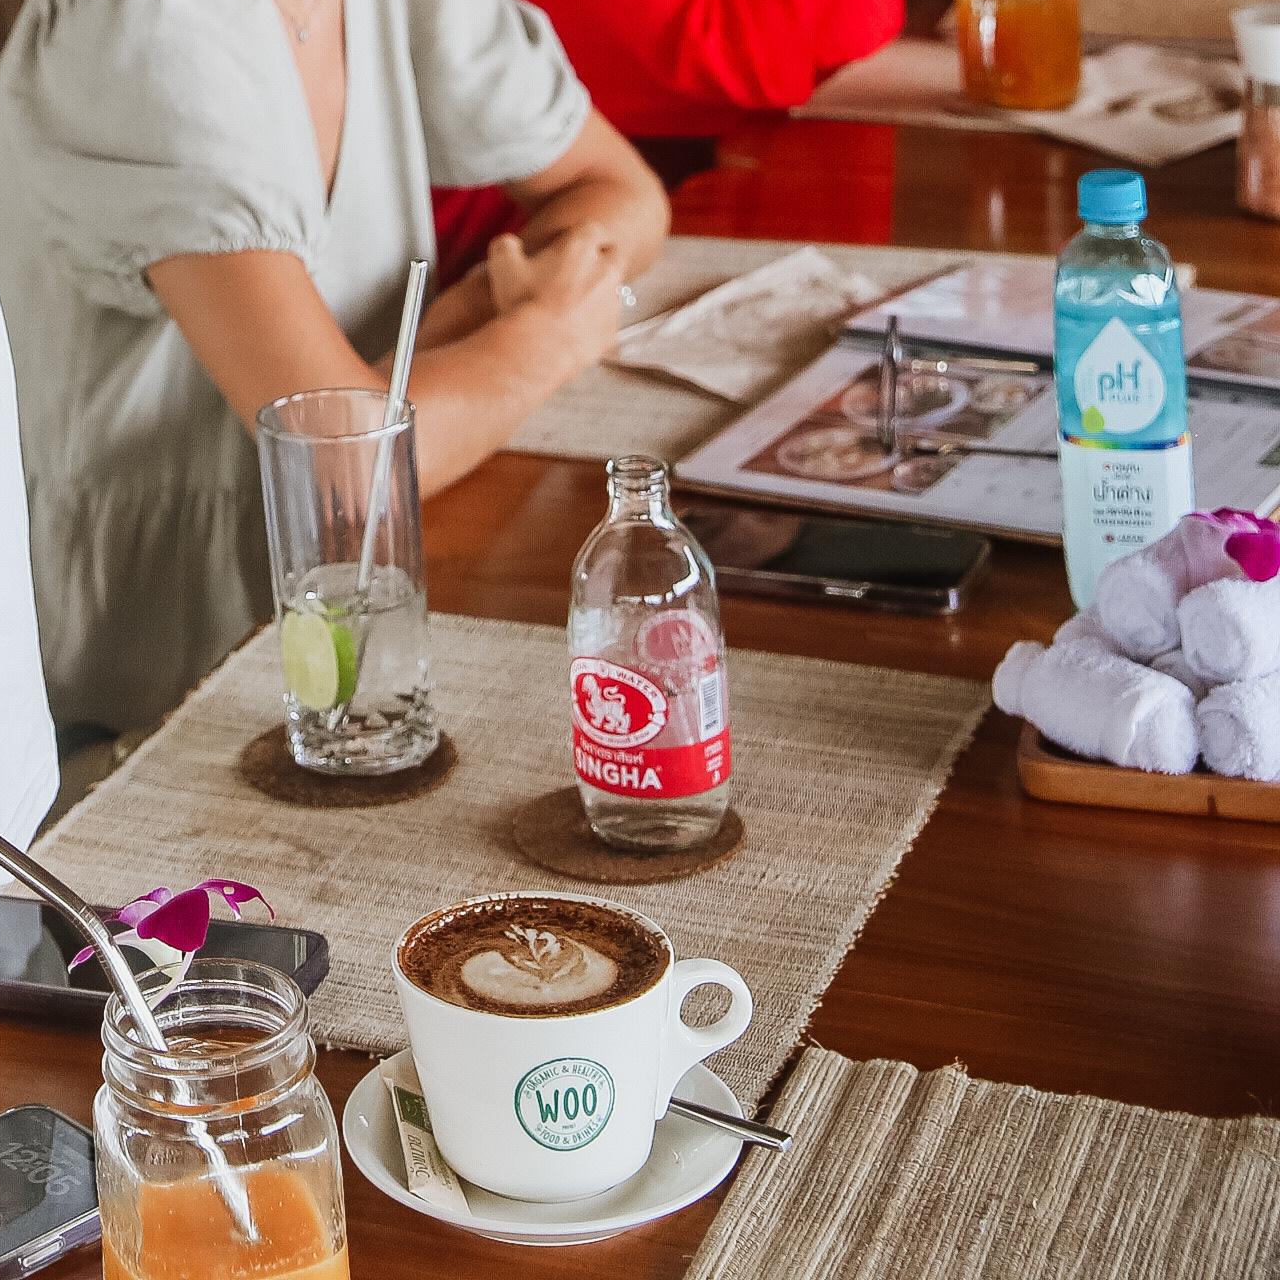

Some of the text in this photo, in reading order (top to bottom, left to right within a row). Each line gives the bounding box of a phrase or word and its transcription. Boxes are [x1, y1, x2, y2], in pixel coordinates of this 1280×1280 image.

[1099, 360, 1143, 401] pH
[526, 1064, 603, 1091] ORGANIC & HEALTHY
[535, 1083, 597, 1123] WOO
[539, 1130, 560, 1145] FOOD
[562, 1136, 570, 1145] &
[572, 1121, 599, 1143] DRINKS
